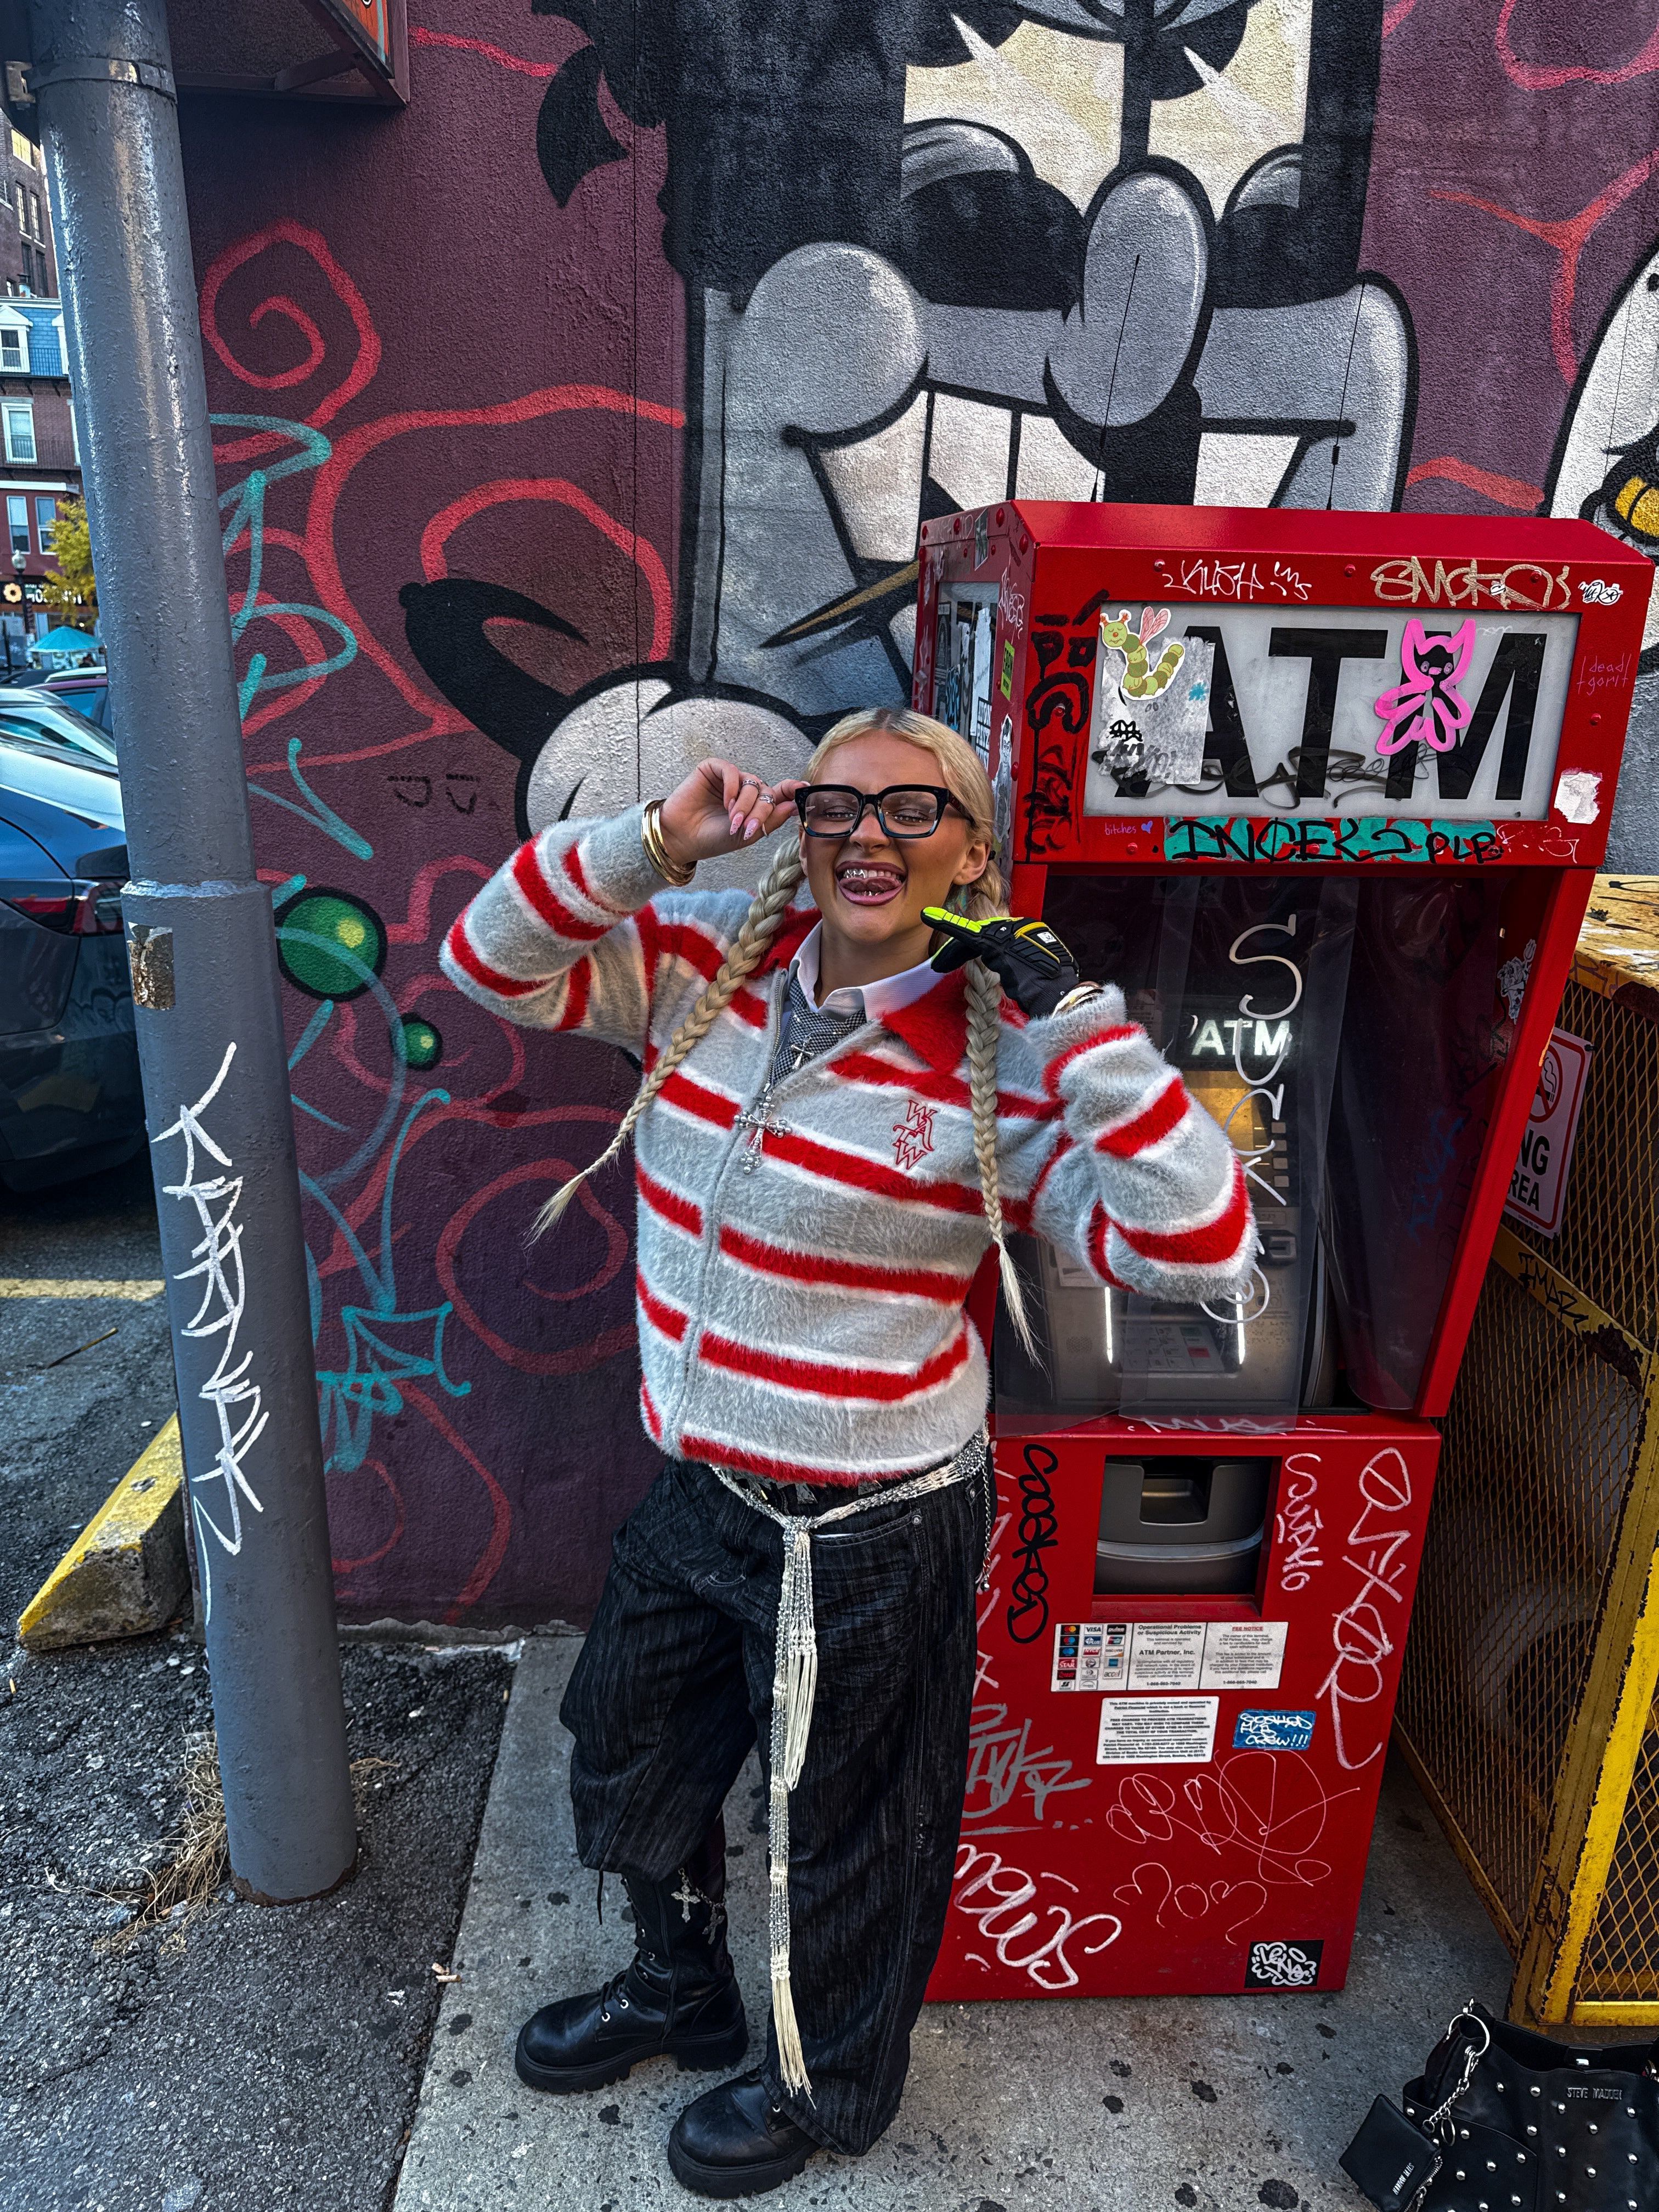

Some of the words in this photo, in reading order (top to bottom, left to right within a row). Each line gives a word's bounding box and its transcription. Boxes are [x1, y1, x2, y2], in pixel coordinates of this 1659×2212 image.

[1589, 653, 1624, 673] dead
[1114, 624, 1548, 800] ATM
[1104, 822, 1137, 836] bitches
[1192, 1019, 1290, 1056] ATM
[1567, 2087, 1589, 2098] STEVE
